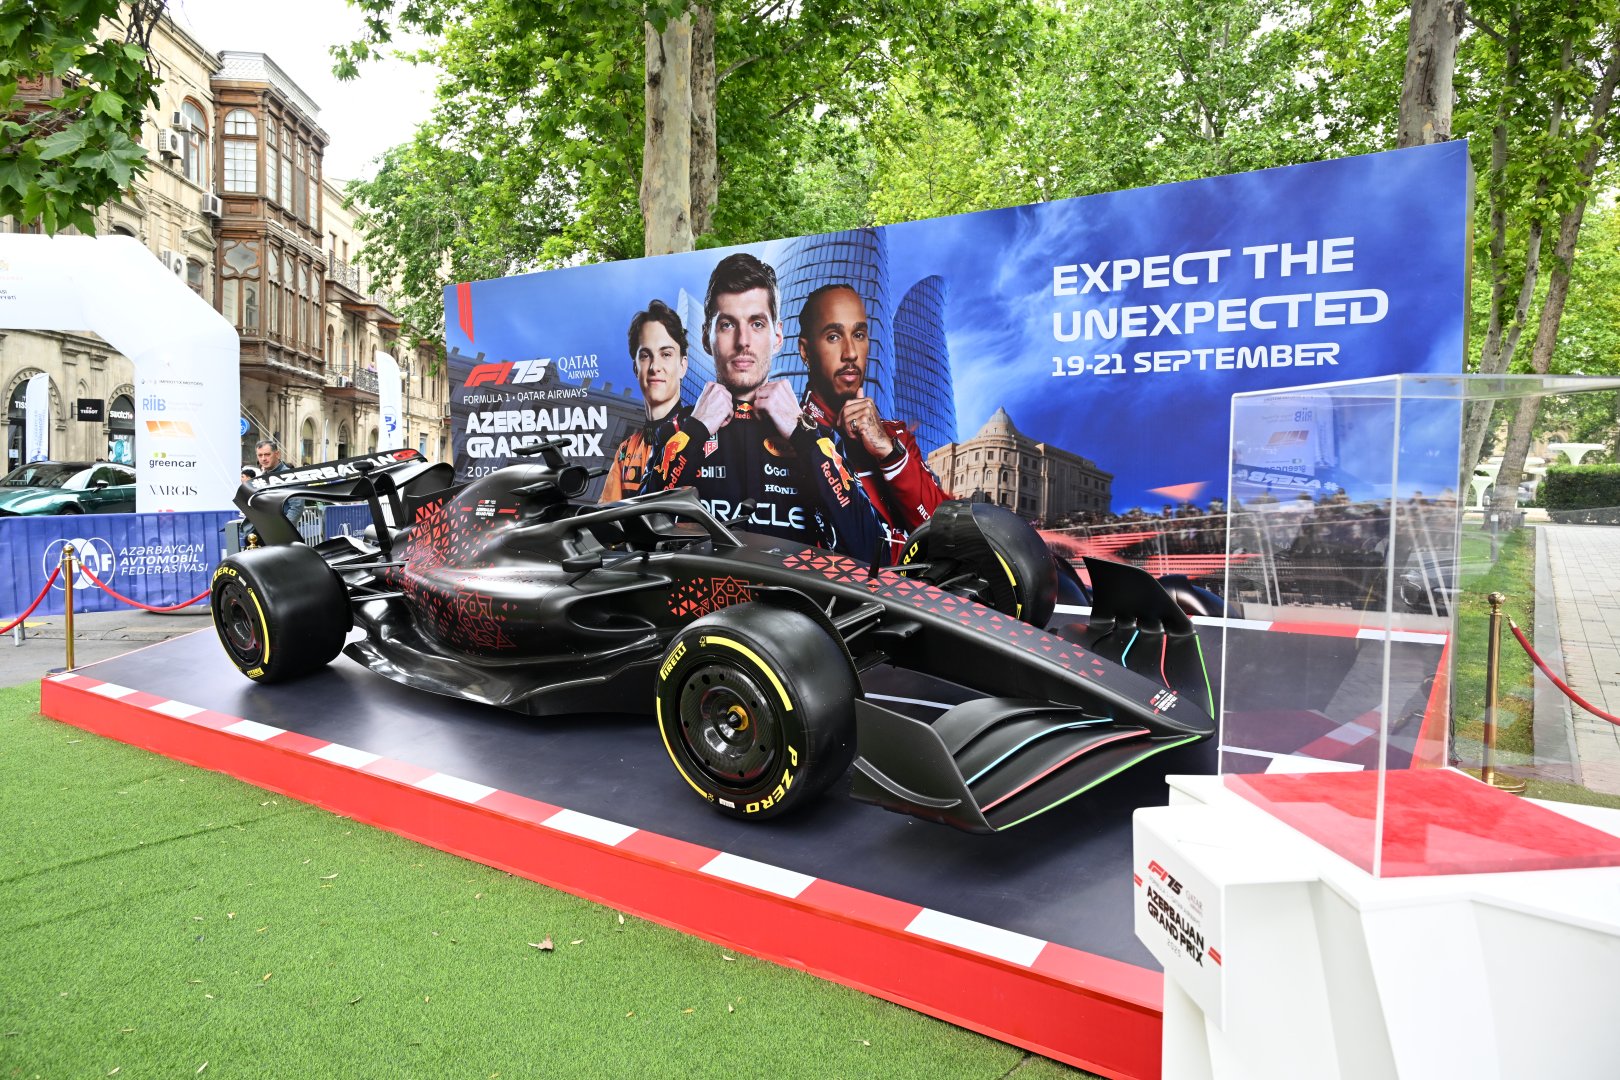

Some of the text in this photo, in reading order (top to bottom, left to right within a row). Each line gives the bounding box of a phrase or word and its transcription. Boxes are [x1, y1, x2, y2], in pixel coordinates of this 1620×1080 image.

[1053, 236, 1354, 297] EXPECT THE
[1053, 288, 1389, 343] UNEXPECTED
[558, 354, 599, 372] QATAR
[567, 368, 599, 381] AIRWAYS
[1051, 342, 1340, 377] 19-21 SEPTEMBER
[463, 387, 588, 405] FORMULA 1 QATAR AIRWAYS
[465, 405, 608, 435] AZERBAIJAN
[149, 460, 197, 468] greencar
[119, 543, 205, 556] AZƏRBAYCAN
[119, 553, 199, 566] AVTOMOBİL
[121, 562, 209, 576] FEDERASİYASI
[660, 641, 687, 681] PIRELLI
[745, 745, 798, 813] P ZERO
[1147, 884, 1205, 952] AZERBAIJAN
[1147, 902, 1179, 941] GRAND
[1179, 931, 1203, 968] PRIX
